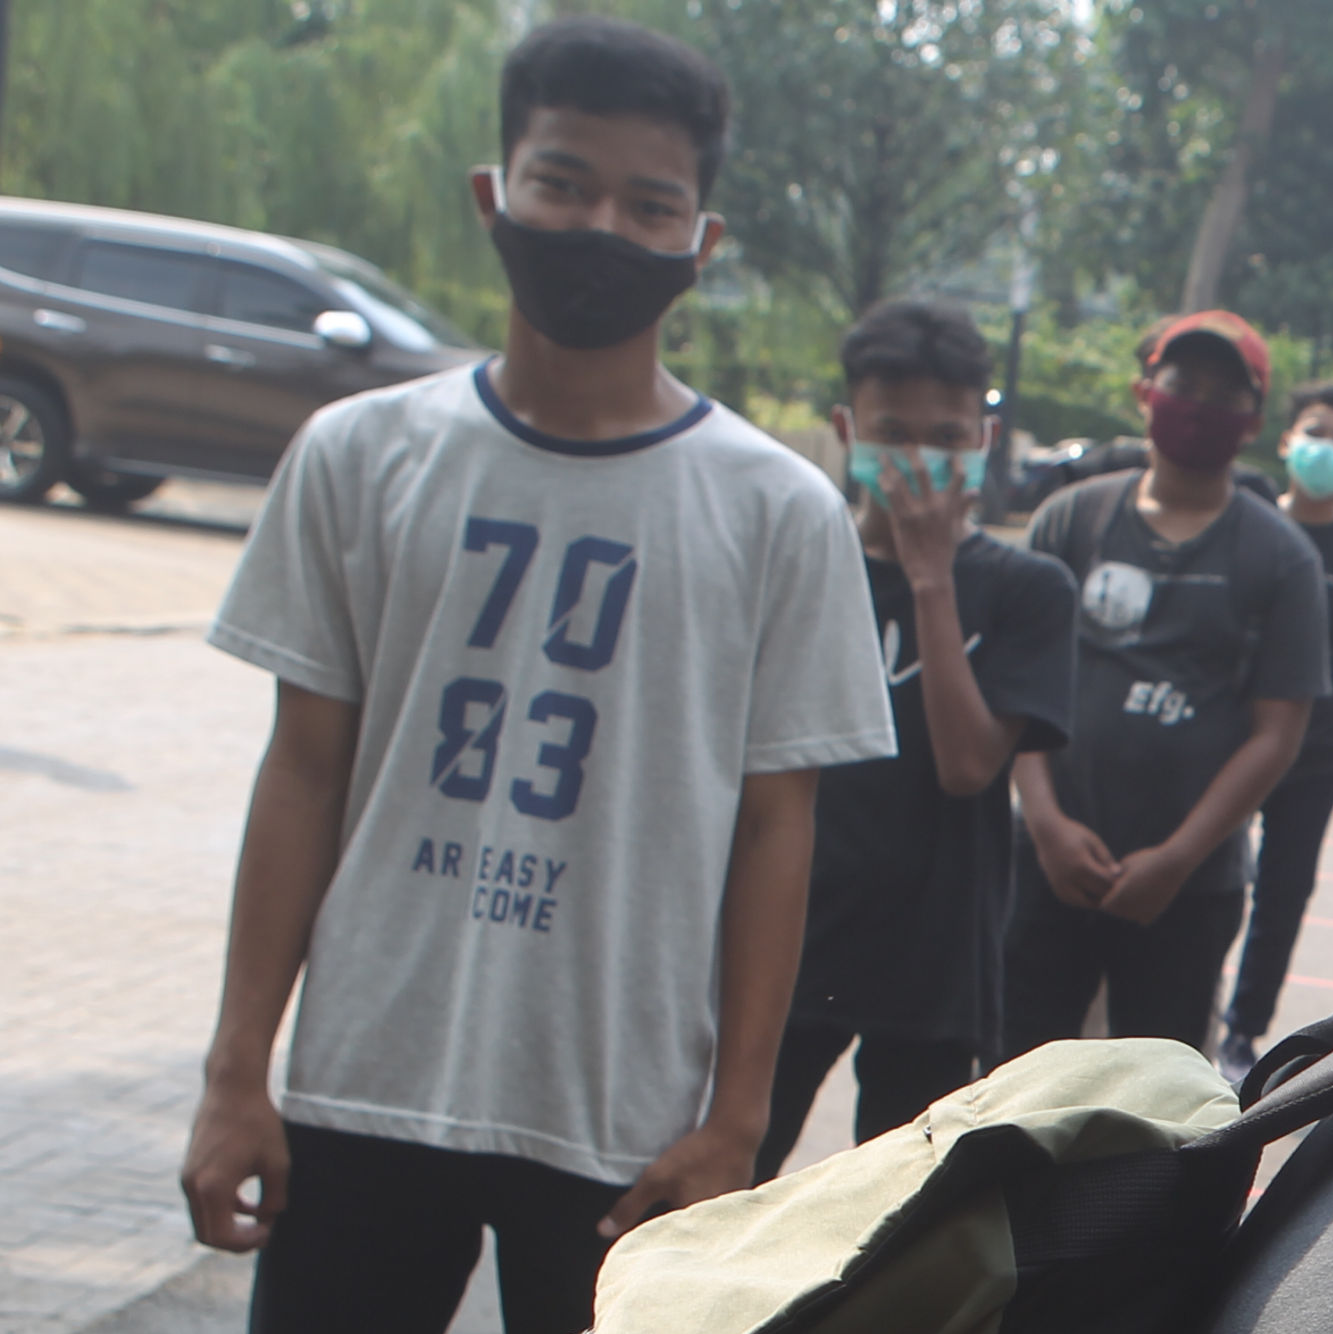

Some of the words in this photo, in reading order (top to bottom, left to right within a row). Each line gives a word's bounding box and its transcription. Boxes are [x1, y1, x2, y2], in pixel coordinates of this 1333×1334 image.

[462, 516, 638, 672] 70
[429, 676, 599, 822] 83
[472, 886, 558, 933] COME
